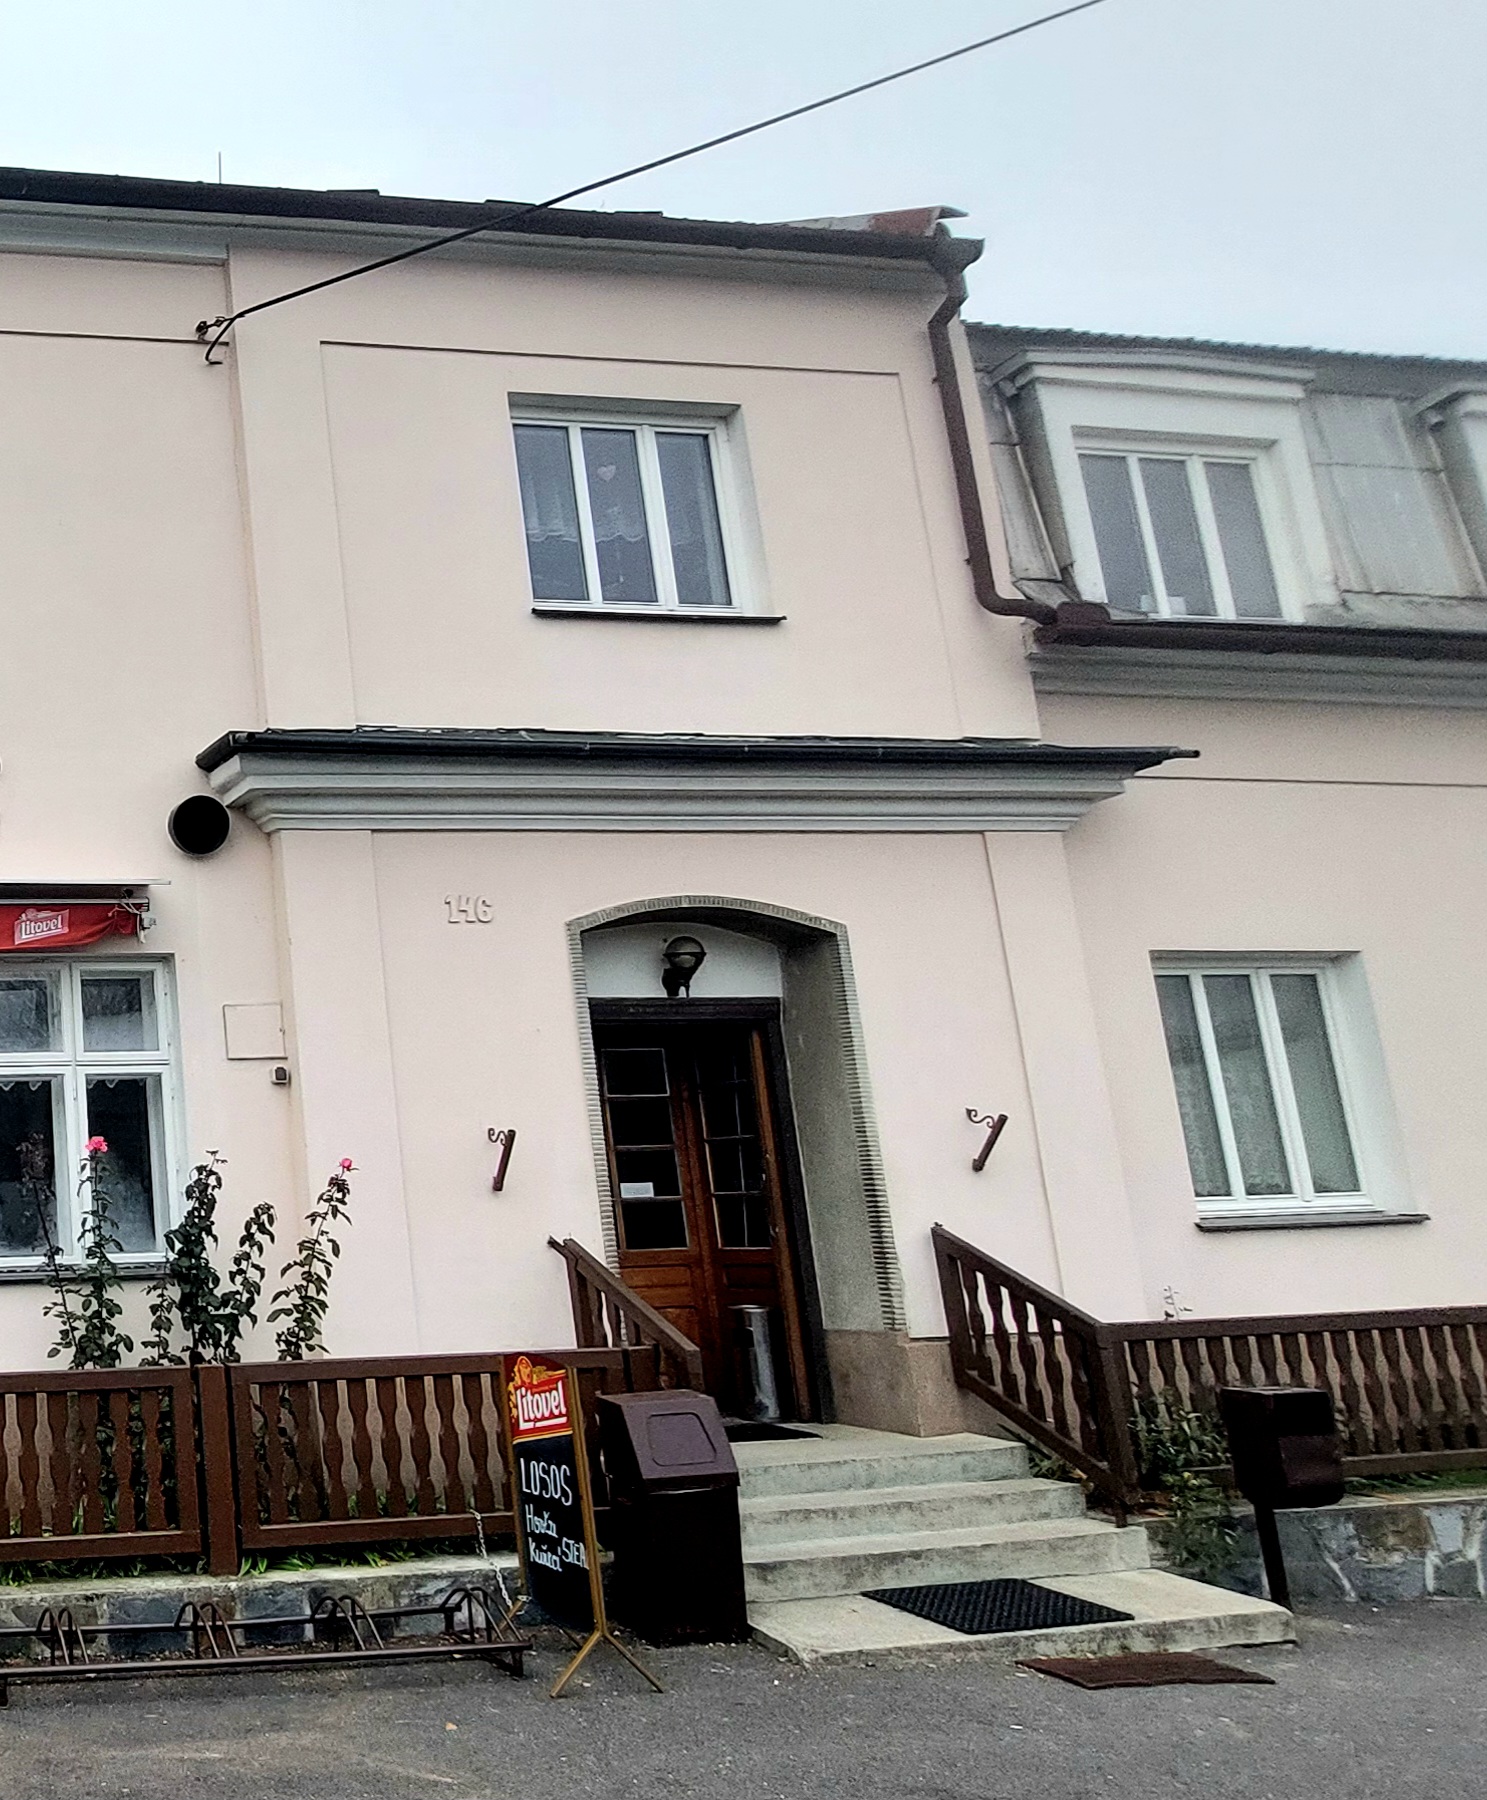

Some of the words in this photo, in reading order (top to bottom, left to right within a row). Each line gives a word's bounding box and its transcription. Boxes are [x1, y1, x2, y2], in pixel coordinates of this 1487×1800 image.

[444, 895, 493, 923] 146
[21, 915, 62, 938] Litovel
[516, 1380, 566, 1430] Litovel
[520, 1458, 572, 1506] LOSOS
[562, 1537, 589, 1570] STEA
